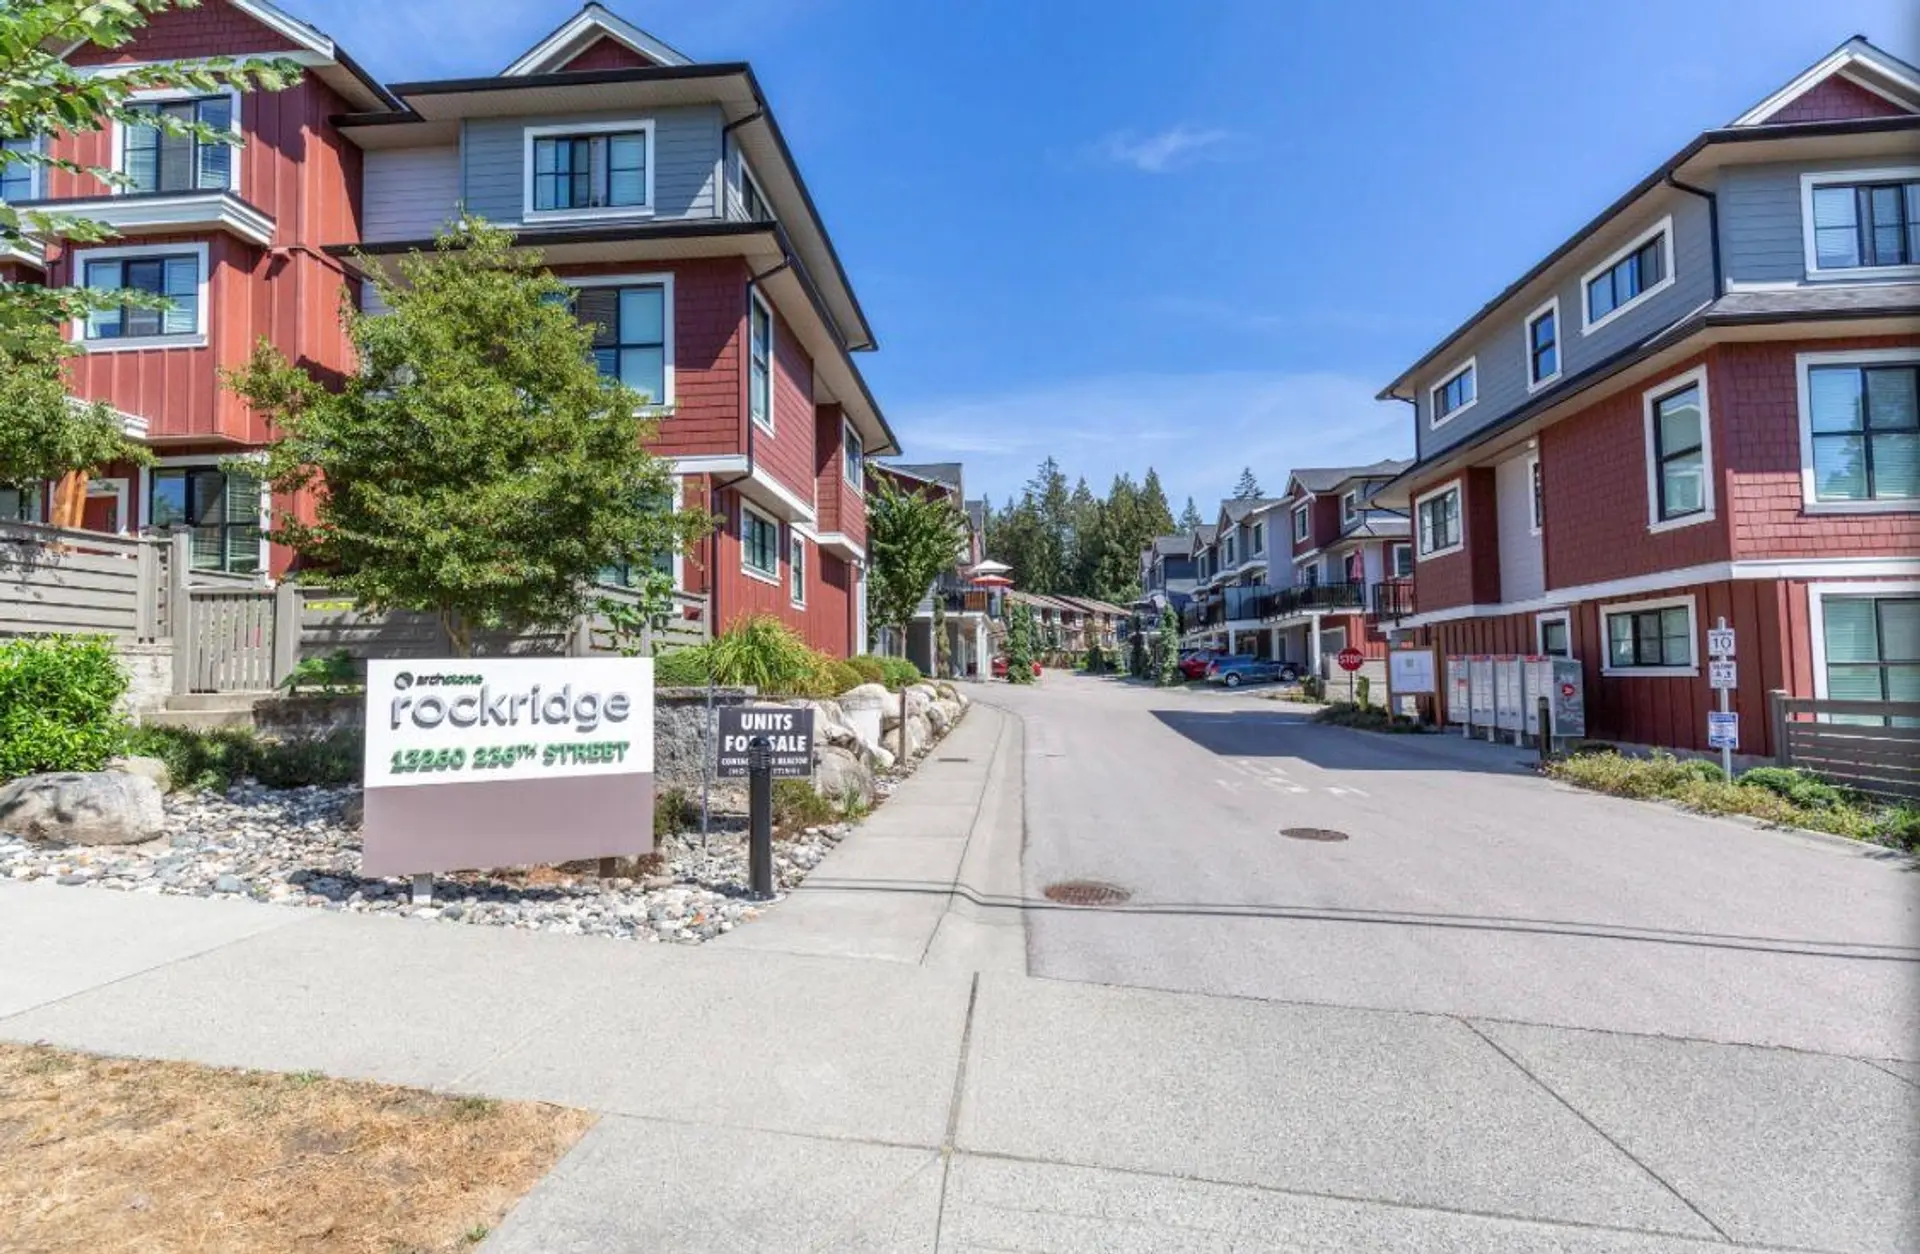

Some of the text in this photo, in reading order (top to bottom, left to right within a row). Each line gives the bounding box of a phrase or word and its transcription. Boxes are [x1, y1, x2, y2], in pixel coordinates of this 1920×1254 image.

[1713, 636, 1732, 649] 10
[1339, 654, 1362, 664] STOP
[390, 683, 631, 734] rockridge
[741, 713, 793, 731] UNITS
[542, 740, 630, 767] STREET
